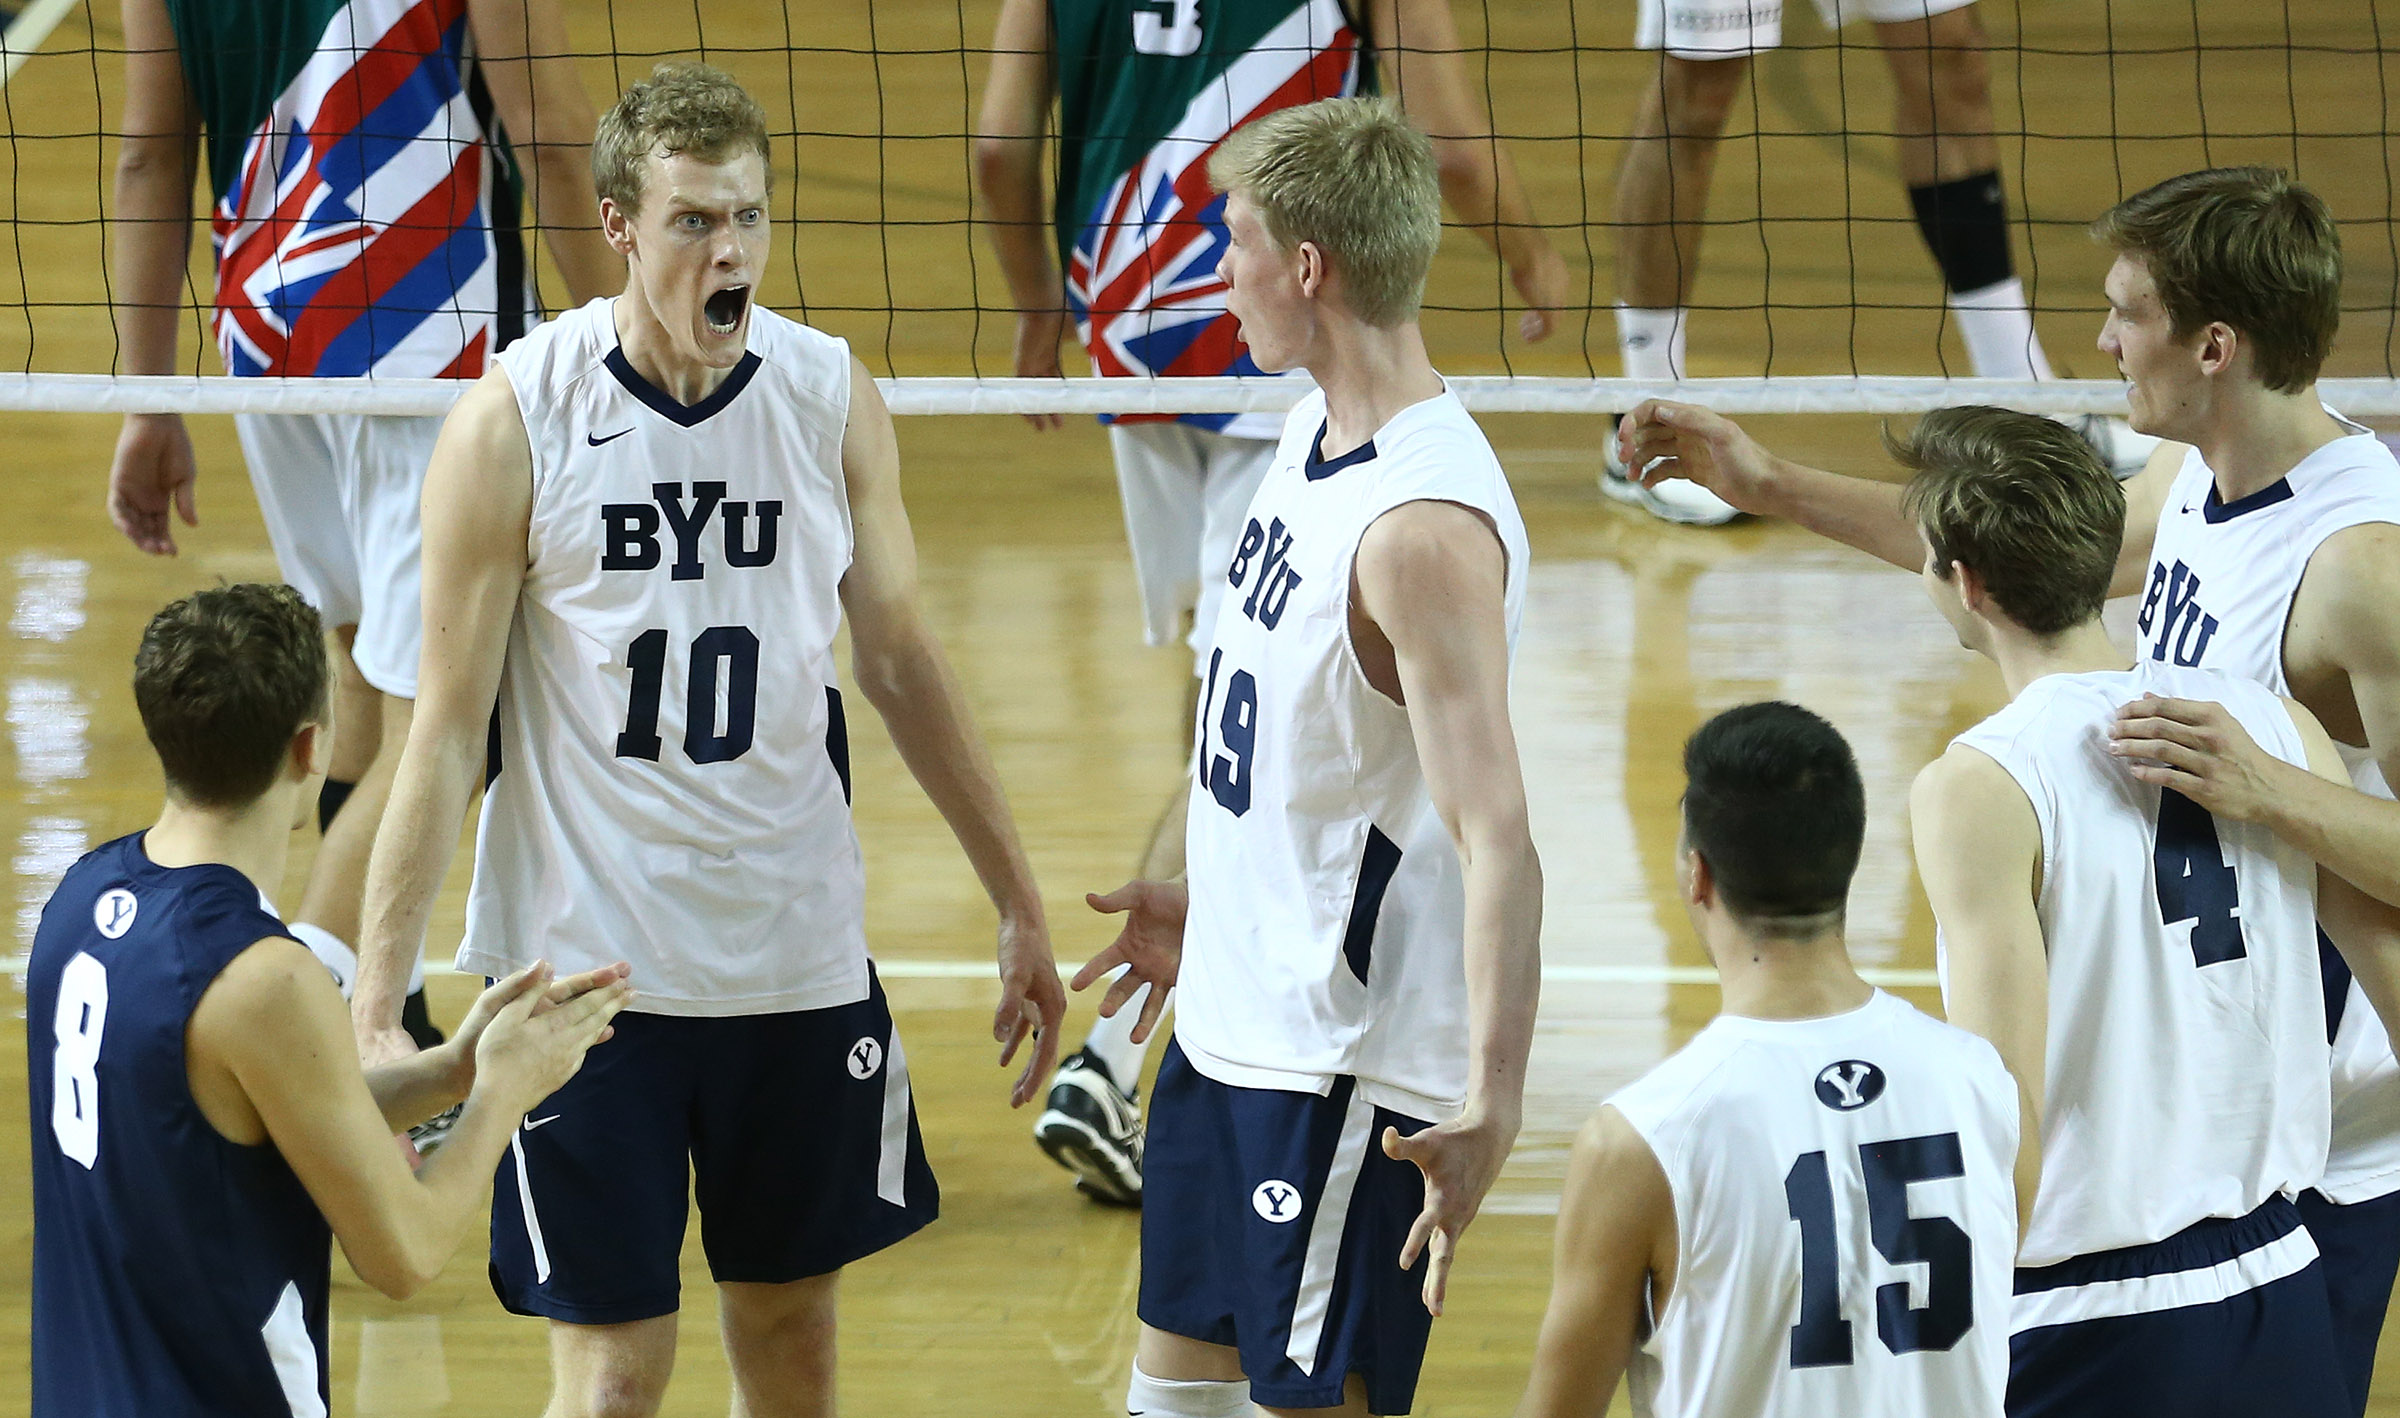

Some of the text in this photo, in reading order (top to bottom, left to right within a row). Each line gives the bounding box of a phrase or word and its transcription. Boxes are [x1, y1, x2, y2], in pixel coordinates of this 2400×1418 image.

[601, 481, 783, 582] BYU
[1228, 516, 1303, 632] BYU
[2138, 558, 2220, 669] BYU
[615, 625, 761, 765] 10
[1200, 646, 1258, 818] 19
[2153, 784, 2248, 969] 4
[52, 949, 110, 1172] 8
[1784, 1131, 1975, 1370] 15
